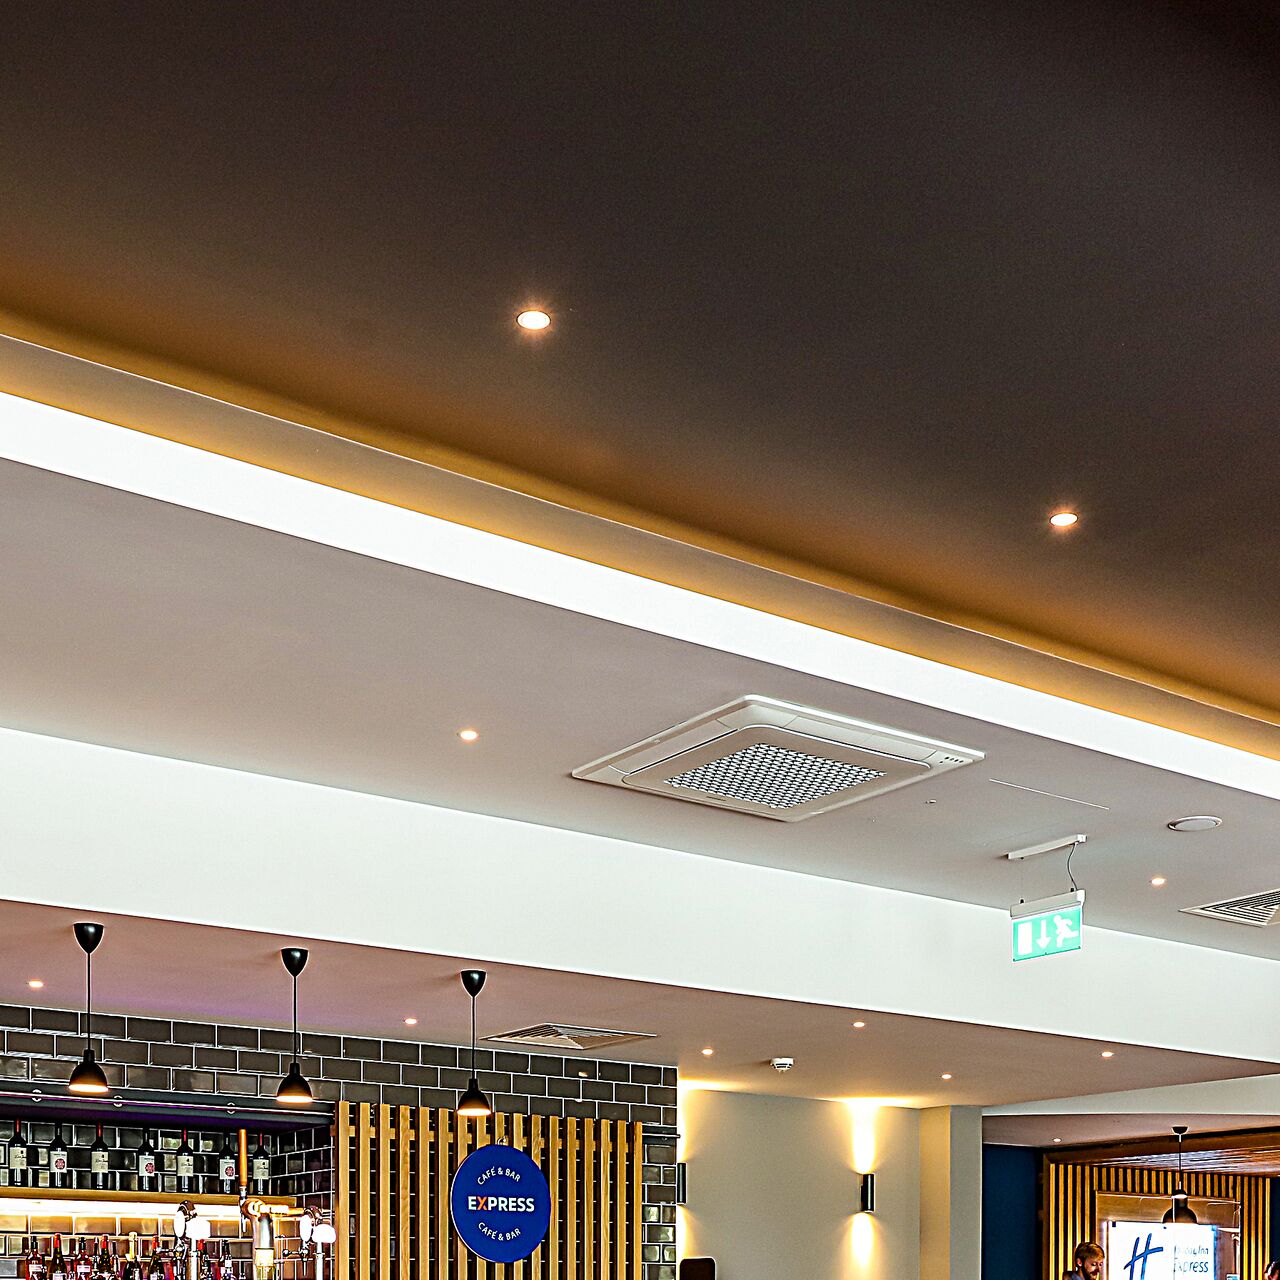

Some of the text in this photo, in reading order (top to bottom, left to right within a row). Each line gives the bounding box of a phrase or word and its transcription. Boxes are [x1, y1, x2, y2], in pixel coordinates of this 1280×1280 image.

[477, 1166, 521, 1185] CAFÉ & BAR
[468, 1196, 535, 1212] EXPRESS
[478, 1222, 497, 1240] CAFÉ
[506, 1228, 521, 1241] BAR
